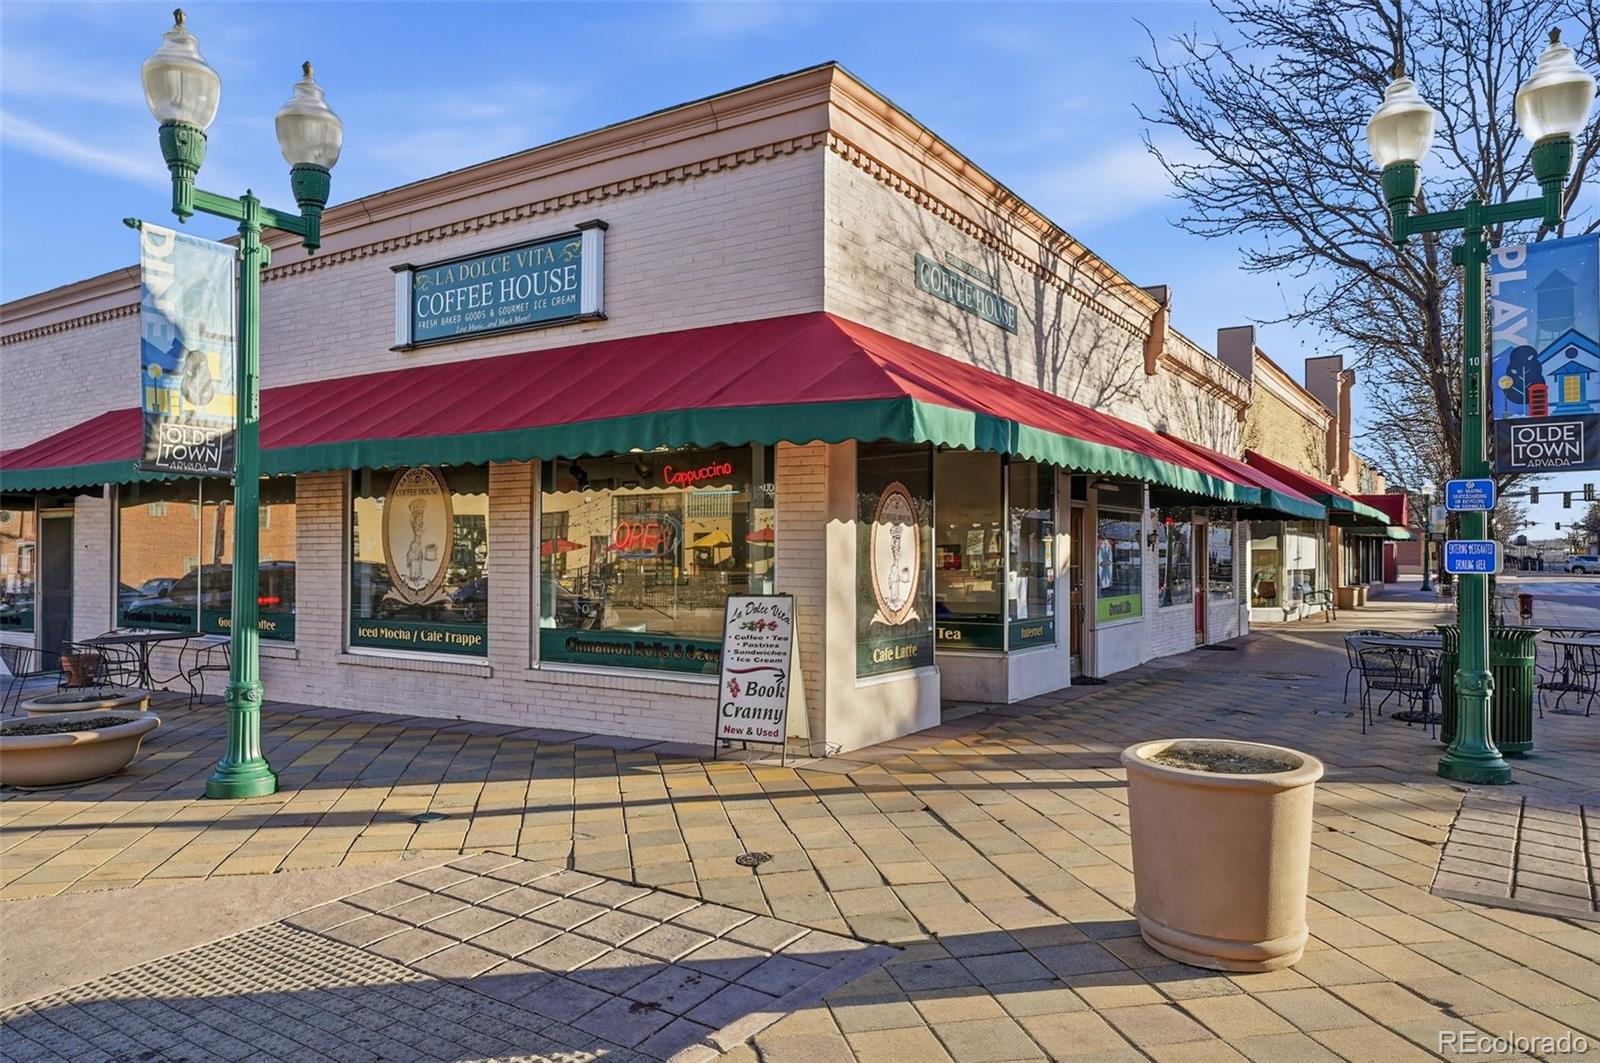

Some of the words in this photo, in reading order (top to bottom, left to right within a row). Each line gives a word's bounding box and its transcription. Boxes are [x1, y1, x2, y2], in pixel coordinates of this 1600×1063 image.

[436, 271, 455, 286] LA
[460, 255, 511, 281] DOLCE
[517, 246, 556, 269] VITA
[141, 222, 176, 341] DINE
[417, 282, 494, 318] COFFEE
[500, 265, 578, 303] HOUSE
[920, 262, 973, 308] COFFEE
[976, 288, 1015, 328] HOUSE
[1491, 245, 1527, 346] PLAY
[418, 318, 438, 330] FRESH
[441, 314, 462, 326] BAKED
[465, 310, 486, 322] GOODS
[490, 308, 495, 317] &
[498, 303, 529, 316] GOURMET
[533, 299, 548, 310] ICE
[551, 294, 576, 308] CREAM
[455, 324, 468, 334] Live
[1468, 356, 1480, 367] 10
[166, 427, 216, 447] OLDE
[1518, 425, 1575, 443] OLDE
[162, 444, 219, 463] TOWN
[1514, 441, 1580, 459] TOWN
[169, 461, 208, 473] ARVADA
[1526, 457, 1571, 469] ARVADA
[663, 461, 732, 487] Cappuccino
[615, 521, 668, 551] OPE
[729, 607, 742, 624] La
[745, 601, 768, 616] Dolce
[770, 604, 790, 625] Vita
[258, 619, 276, 631] offee
[936, 627, 962, 640] Tea
[1021, 626, 1043, 639] Internet
[358, 627, 378, 638] Iced
[380, 627, 411, 640] Mocha
[413, 630, 418, 643] /
[420, 629, 443, 642] Cafe
[445, 631, 482, 646] Frappe
[565, 636, 632, 656] Cinnamon
[633, 641, 670, 658] Rolls
[672, 643, 683, 660] &
[873, 647, 895, 663] Cafe
[895, 643, 918, 659] Latte
[745, 681, 786, 698] Book
[722, 702, 784, 725] Cranny
[723, 725, 743, 735] New
[746, 727, 753, 736] &
[756, 728, 779, 738] Used
